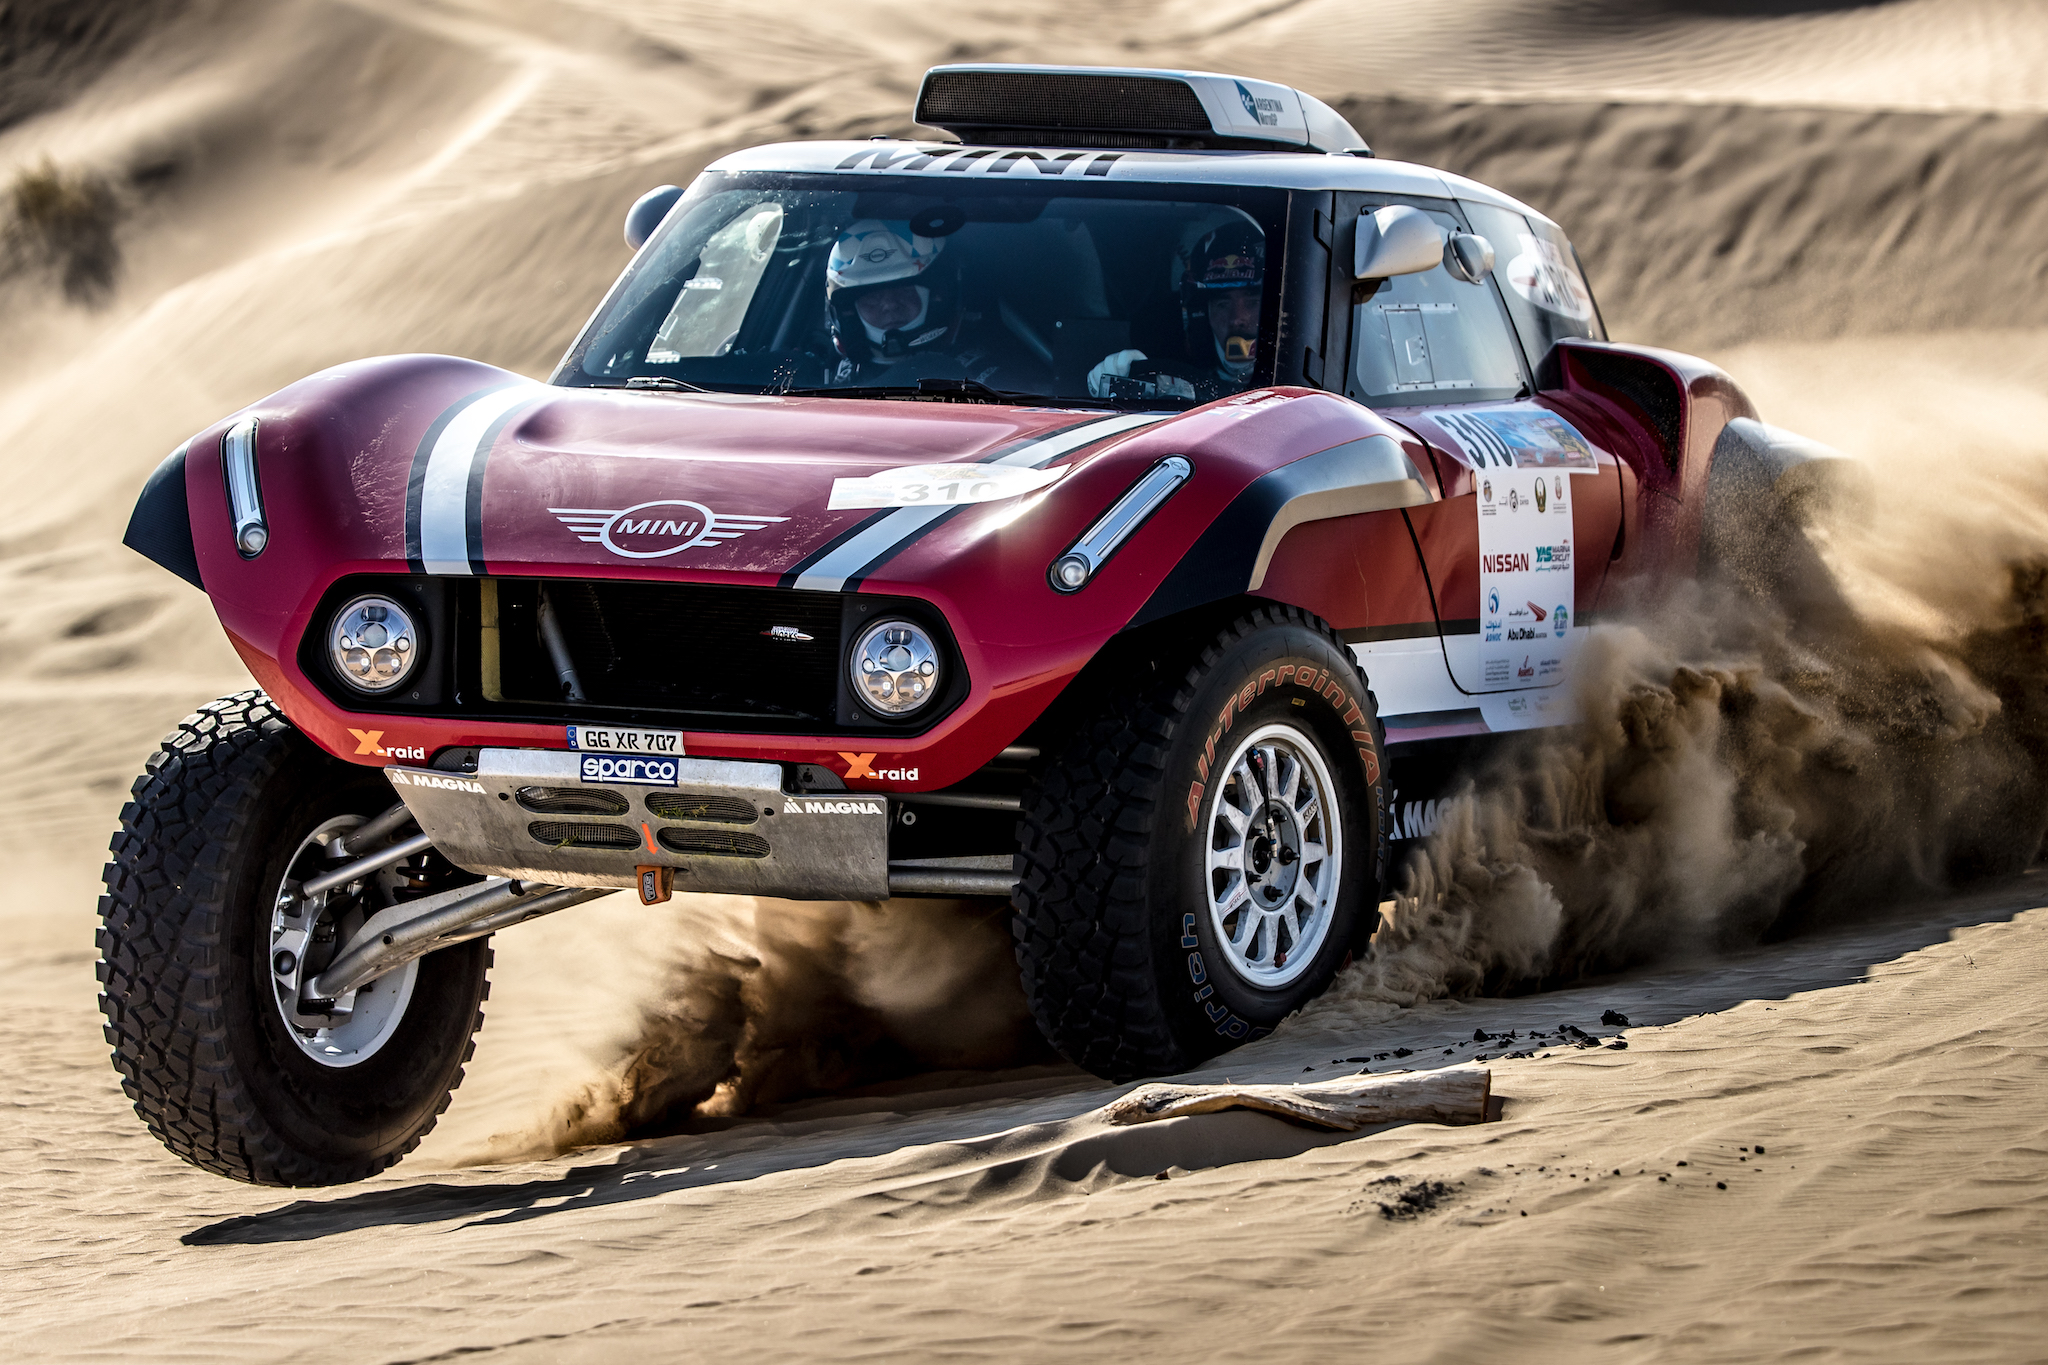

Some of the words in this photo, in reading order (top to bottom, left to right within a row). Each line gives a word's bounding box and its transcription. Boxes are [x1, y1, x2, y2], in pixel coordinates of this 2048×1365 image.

[834, 148, 1125, 177] MINI
[1434, 413, 1513, 469] 310
[900, 481, 1000, 502] 310
[615, 516, 699, 537] MINI
[1536, 546, 1552, 562] YAS
[1552, 545, 1570, 553] MARINA
[1483, 553, 1529, 573] NISSAN
[1507, 629, 1519, 641] Abu
[1519, 627, 1535, 640] Dhabi
[347, 728, 425, 759] X-raid
[585, 731, 610, 748] GG
[615, 732, 640, 750] XR
[644, 734, 676, 751] 707
[582, 757, 676, 782] sparco
[837, 752, 919, 780] X-raid
[412, 774, 488, 794] MAGNA
[805, 802, 883, 815] MAGNA
